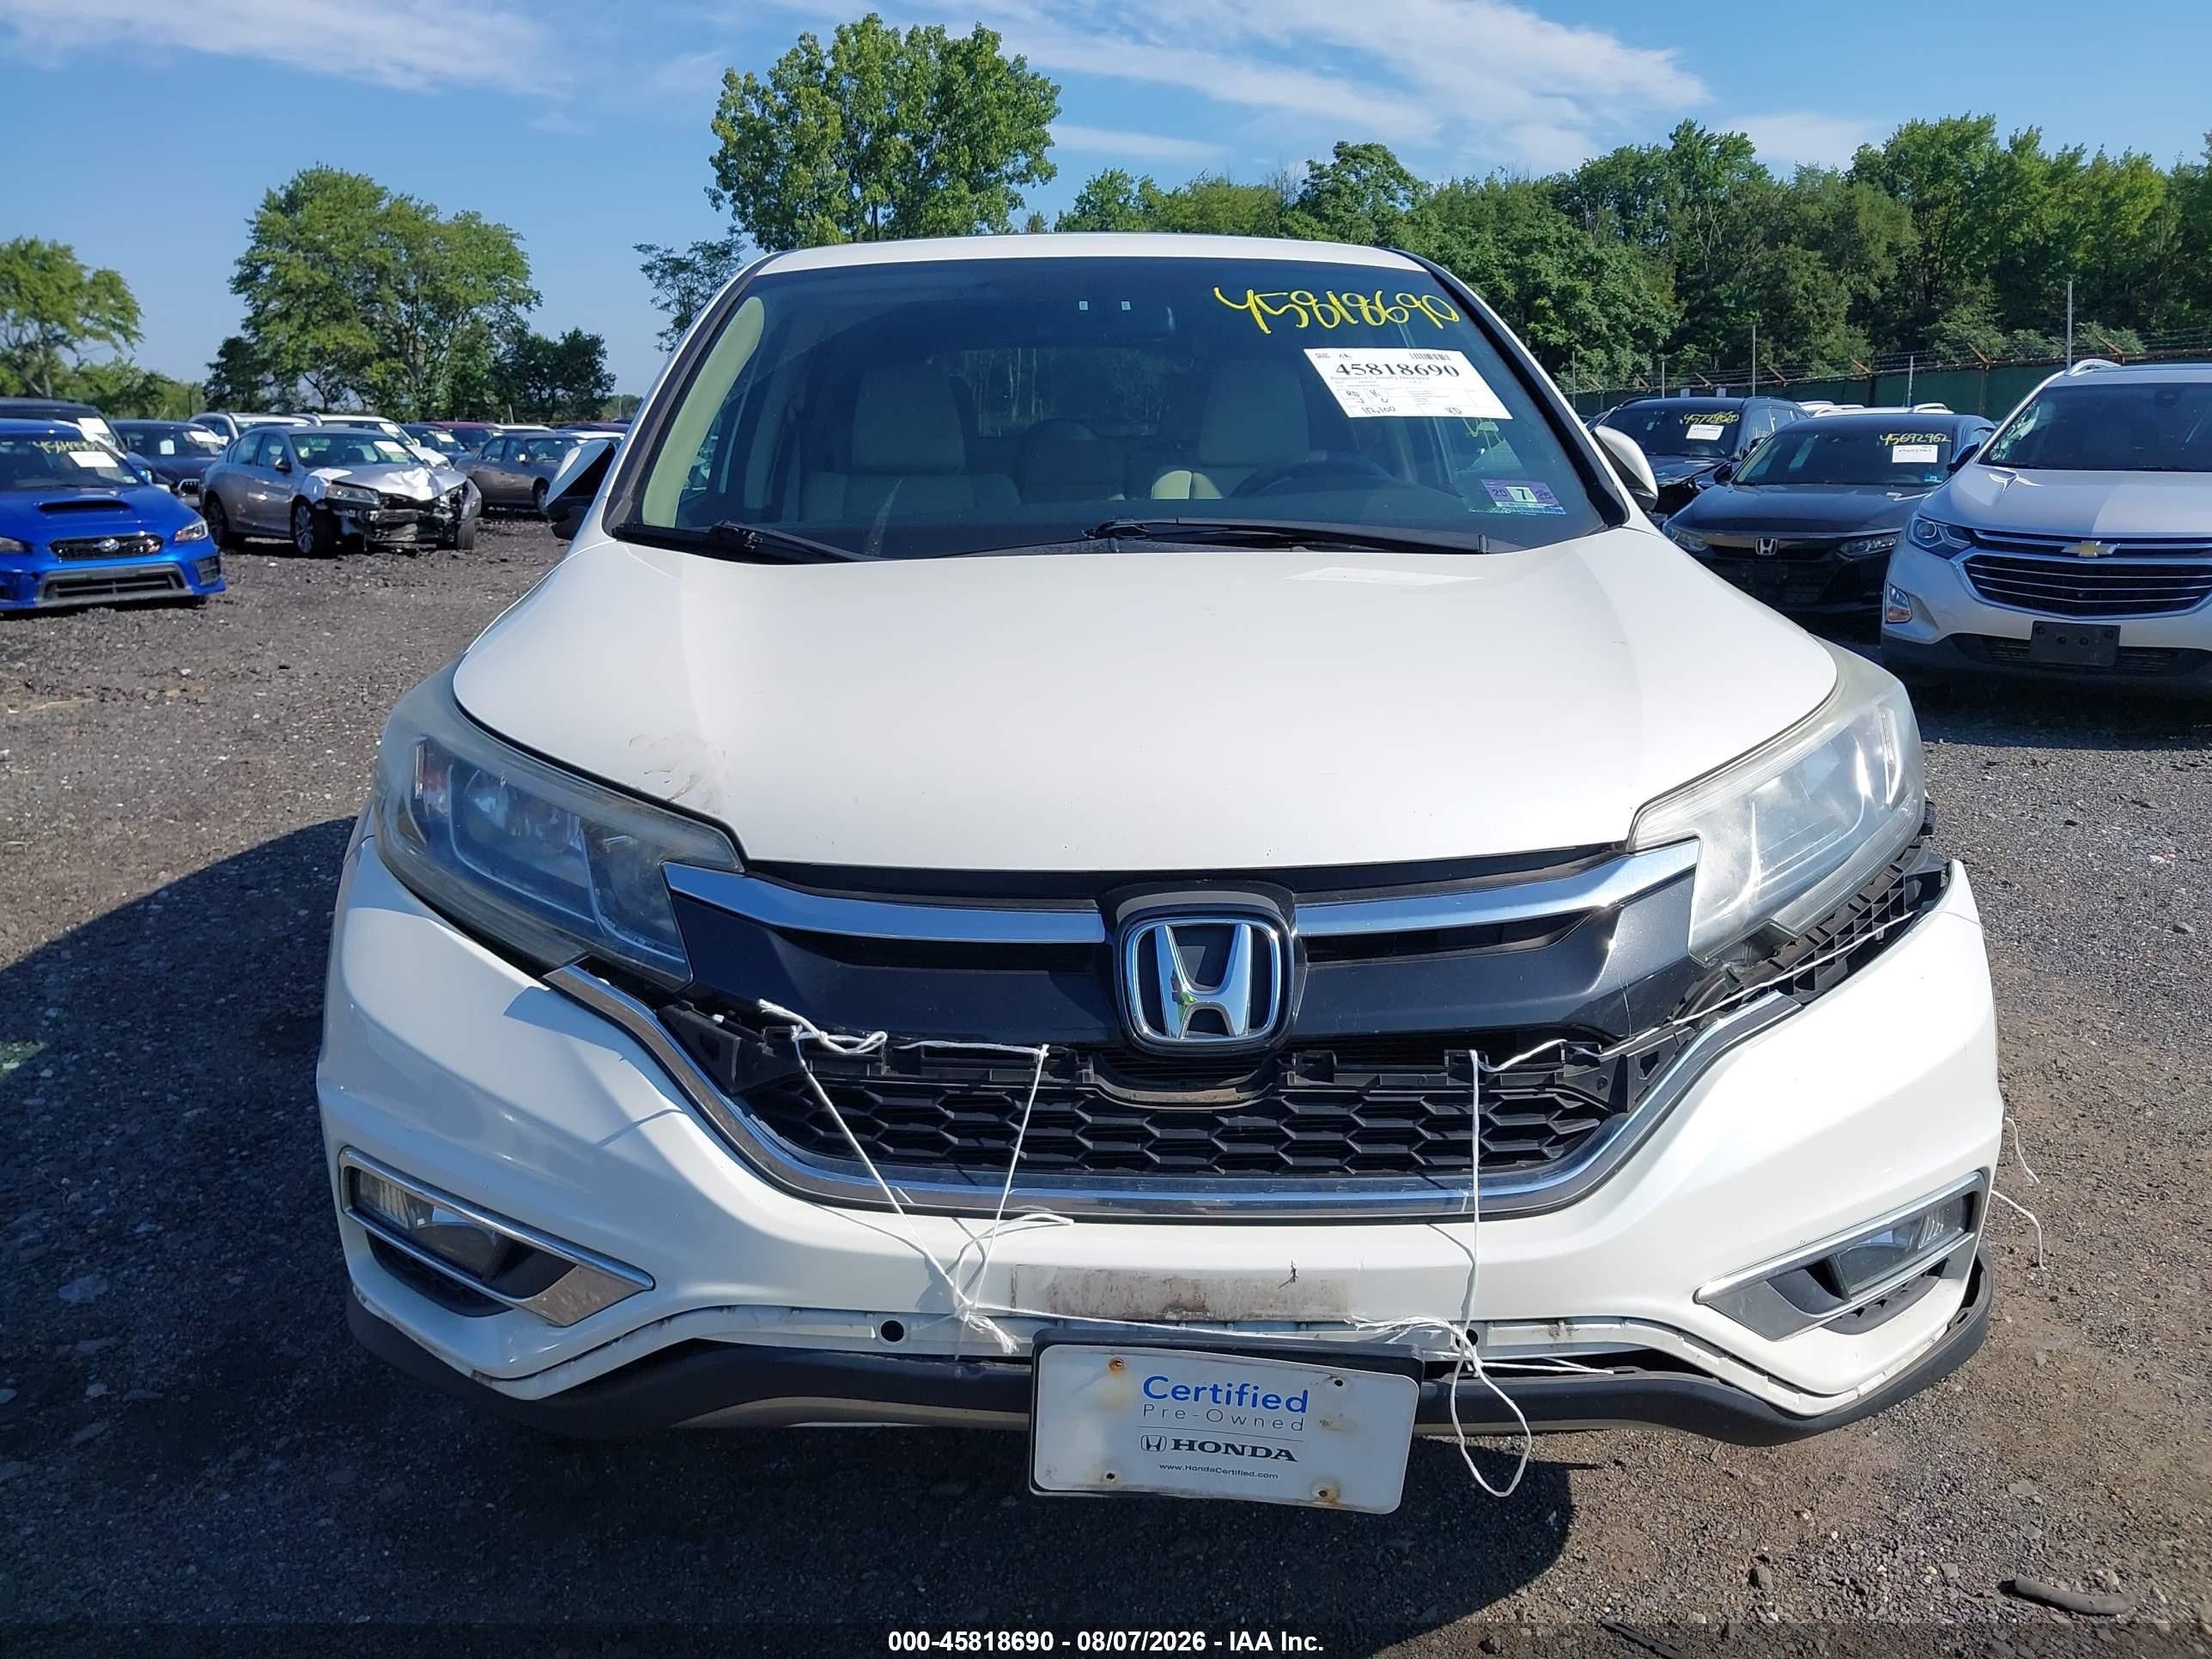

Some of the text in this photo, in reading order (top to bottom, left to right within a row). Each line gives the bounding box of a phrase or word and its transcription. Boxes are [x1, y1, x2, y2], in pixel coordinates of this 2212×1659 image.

[1213, 287, 1461, 335] 45818690
[1336, 363, 1460, 378] 45818690
[1879, 433, 1952, 447] 45692962
[1516, 488, 1526, 500] 7
[1143, 1376, 1310, 1413] Certified
[1143, 1403, 1304, 1431] Pre-Owned
[1171, 1438, 1298, 1462] HONDA
[1159, 1464, 1279, 1480] www.HondaCertified.com
